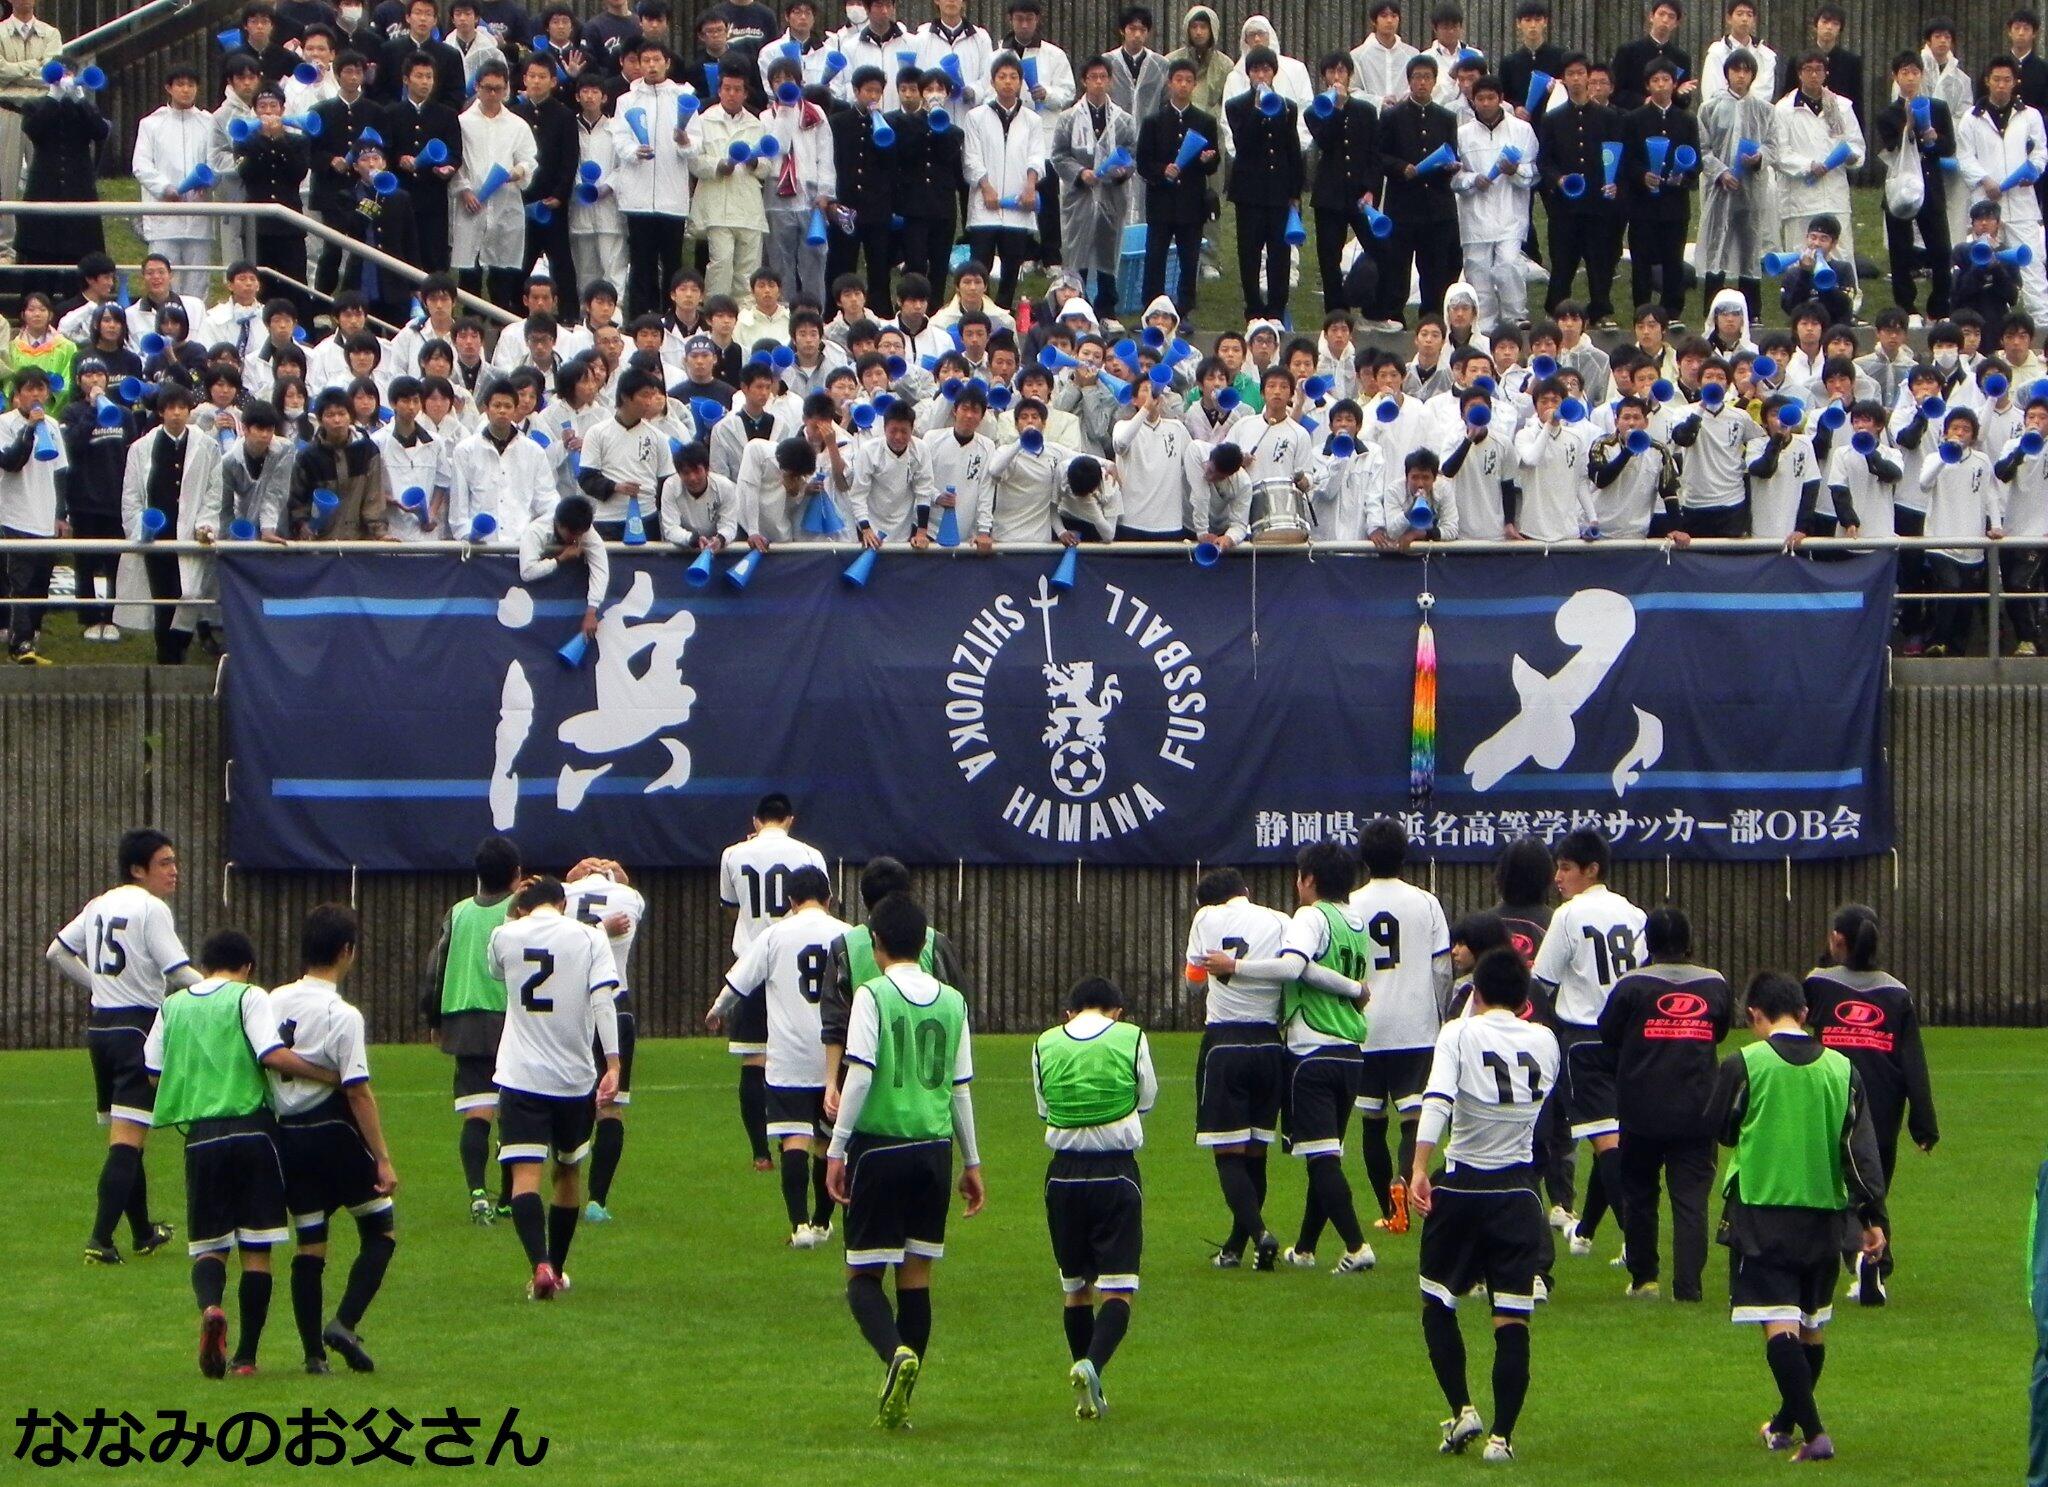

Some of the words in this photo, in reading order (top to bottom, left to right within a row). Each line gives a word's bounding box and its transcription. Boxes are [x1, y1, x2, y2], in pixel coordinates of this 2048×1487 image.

[945, 594, 1026, 783] SHIZUOKA
[1105, 583, 1207, 770] FUSSBALL
[1002, 782, 1166, 842] HAMANA
[1255, 805, 1861, 847] 静岡県浜名高等学校サッカー部OB会
[741, 863, 792, 918] 10
[94, 914, 128, 976] 15
[1368, 911, 1400, 970] 9
[1582, 924, 1636, 986] 18
[520, 948, 554, 1012] 2
[797, 943, 828, 1003] 8
[891, 1015, 947, 1090] 10
